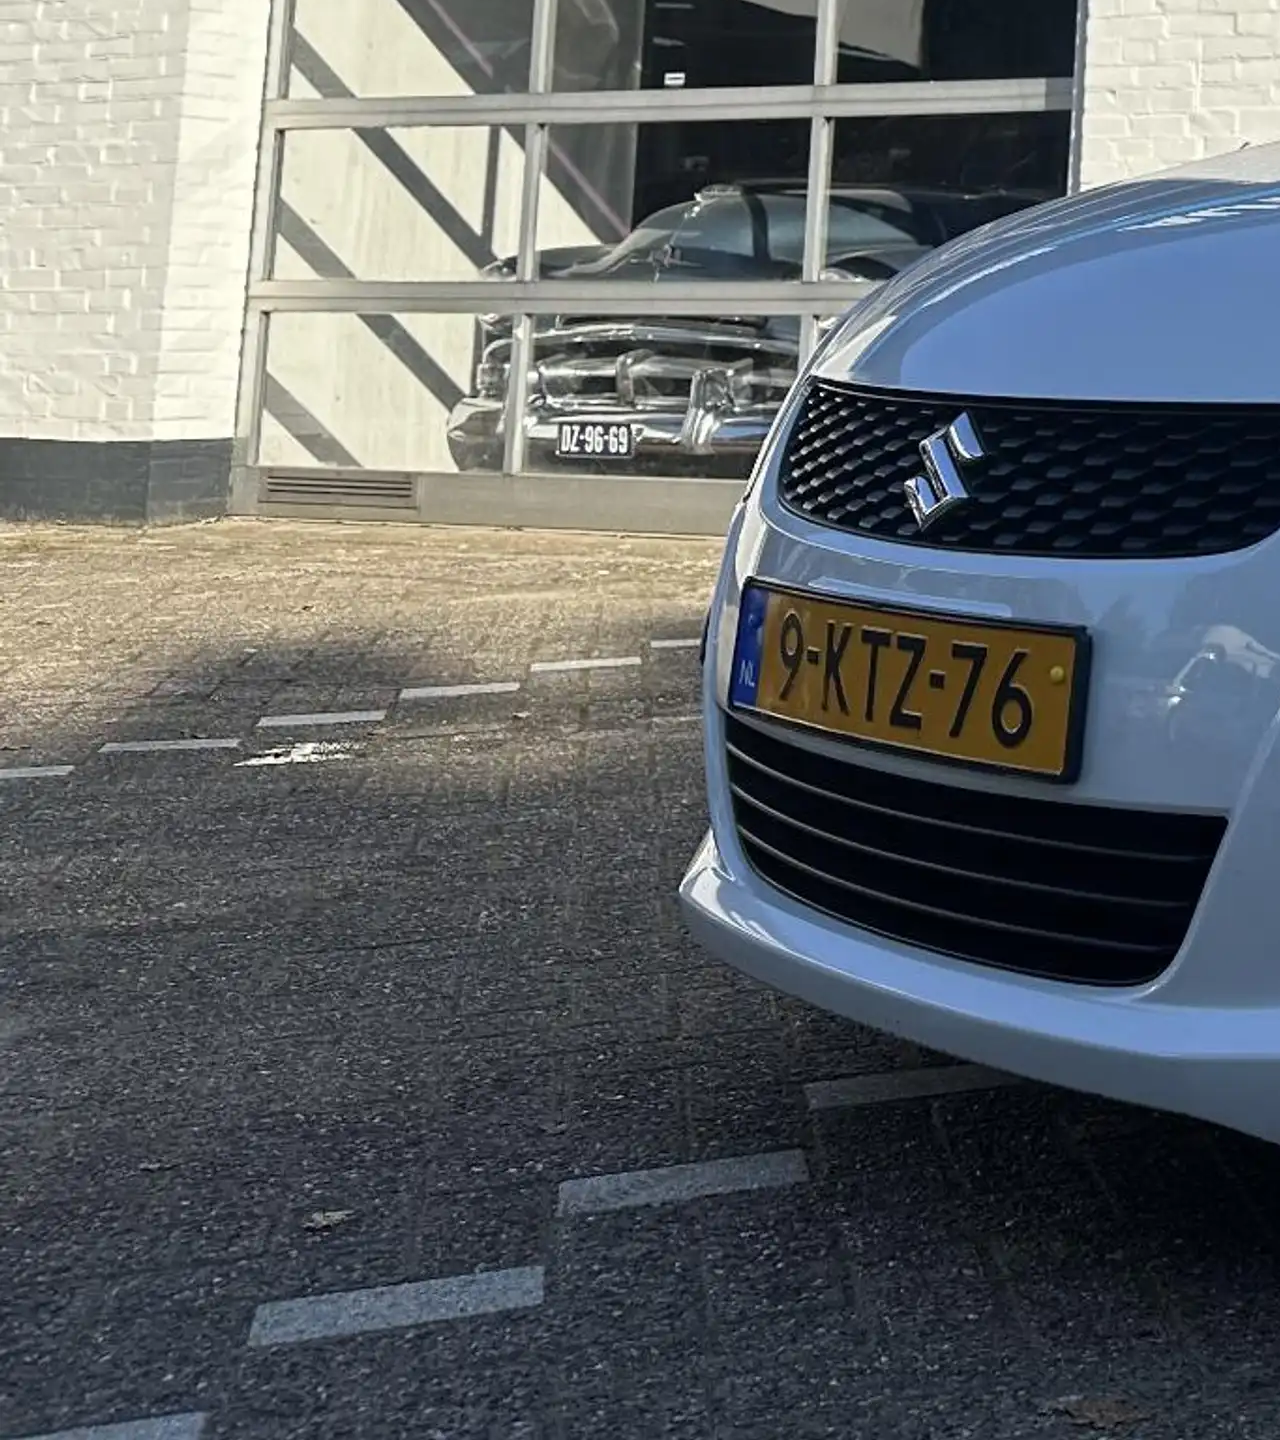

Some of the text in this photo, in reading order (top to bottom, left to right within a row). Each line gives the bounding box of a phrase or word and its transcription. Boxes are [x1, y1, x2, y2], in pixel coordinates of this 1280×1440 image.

[560, 424, 629, 454] DZ-96-69
[738, 659, 756, 689] NL
[779, 610, 1033, 749] 9-KTZ-76
